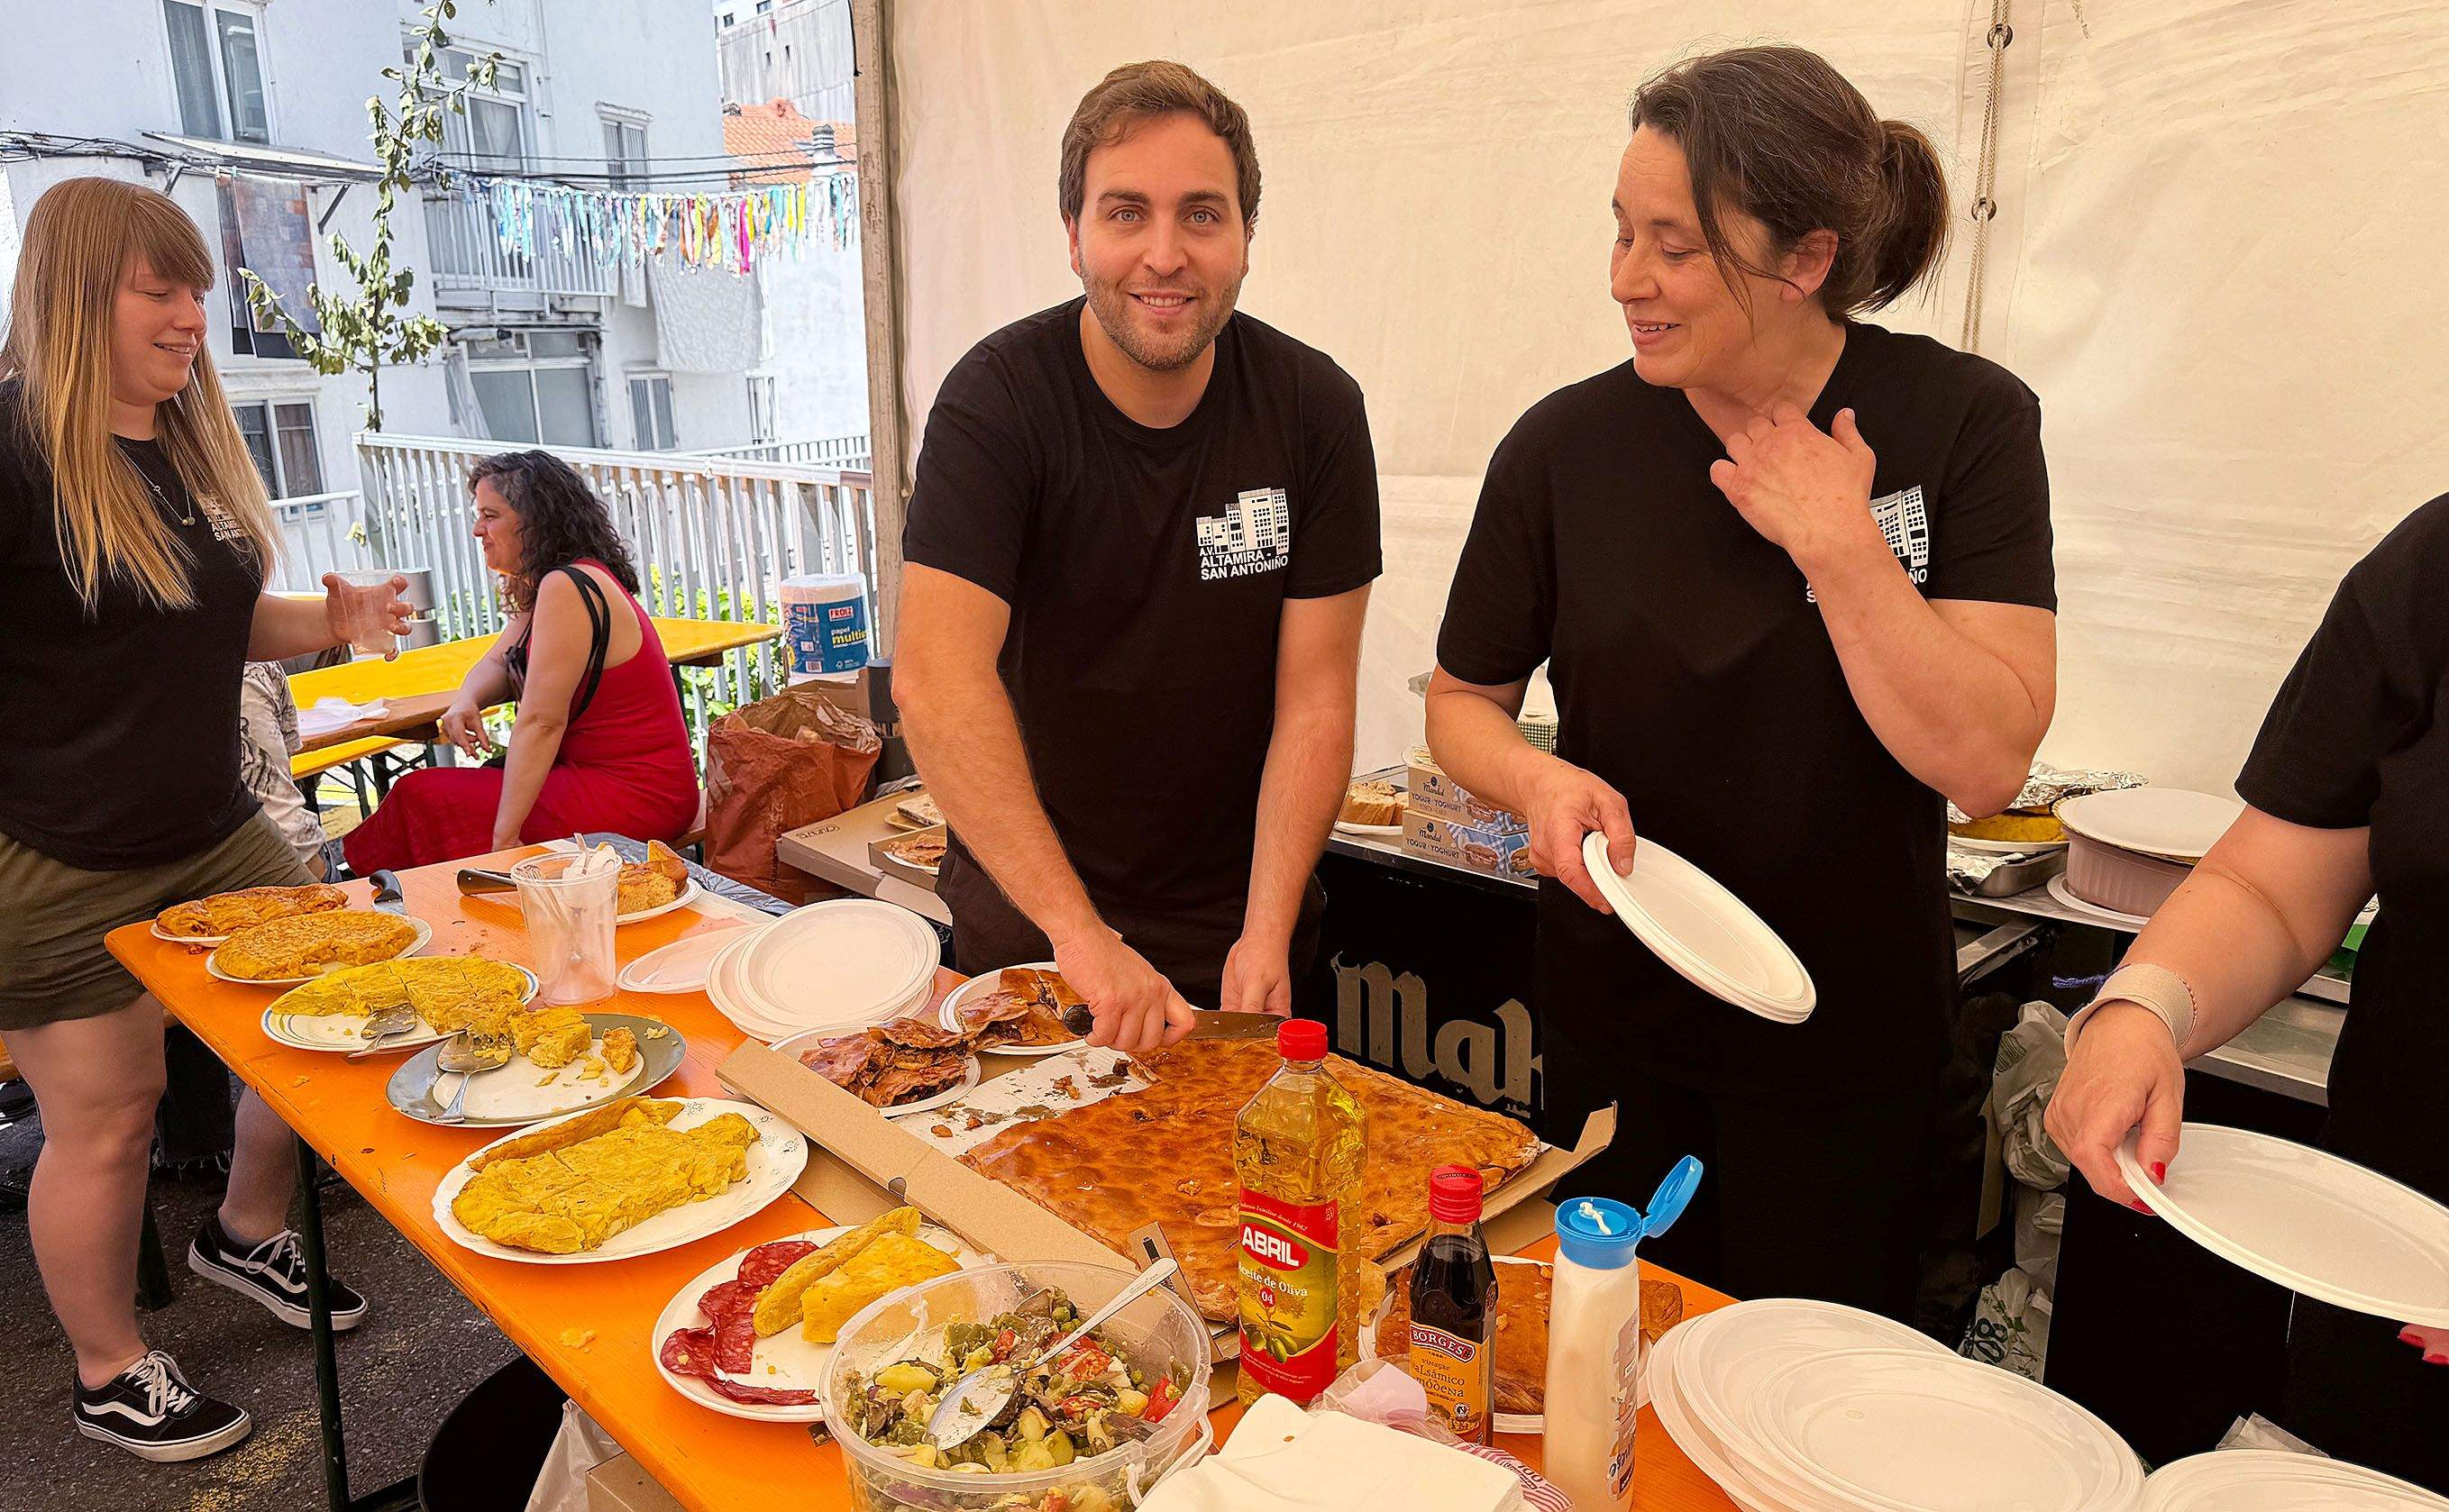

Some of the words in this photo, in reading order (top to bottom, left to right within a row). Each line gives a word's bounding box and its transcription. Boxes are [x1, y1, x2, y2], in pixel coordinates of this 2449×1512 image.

[1199, 546, 1215, 557] A.V.
[1201, 550, 1266, 569] ALTAMIRA
[1201, 566, 1228, 580] SAN
[1229, 555, 1288, 578] ANTONIÑO
[1411, 792, 1431, 805] YOGUR
[1406, 837, 1427, 850] YOGUR
[1330, 951, 1544, 1119] Mah
[1241, 1226, 1300, 1267] ABRIL
[1264, 1275, 1277, 1289] de
[1278, 1281, 1309, 1297] Oliva
[1261, 1290, 1274, 1305] 04
[1412, 1330, 1465, 1355] BORGES
[1518, 1462, 1544, 1482] 100
